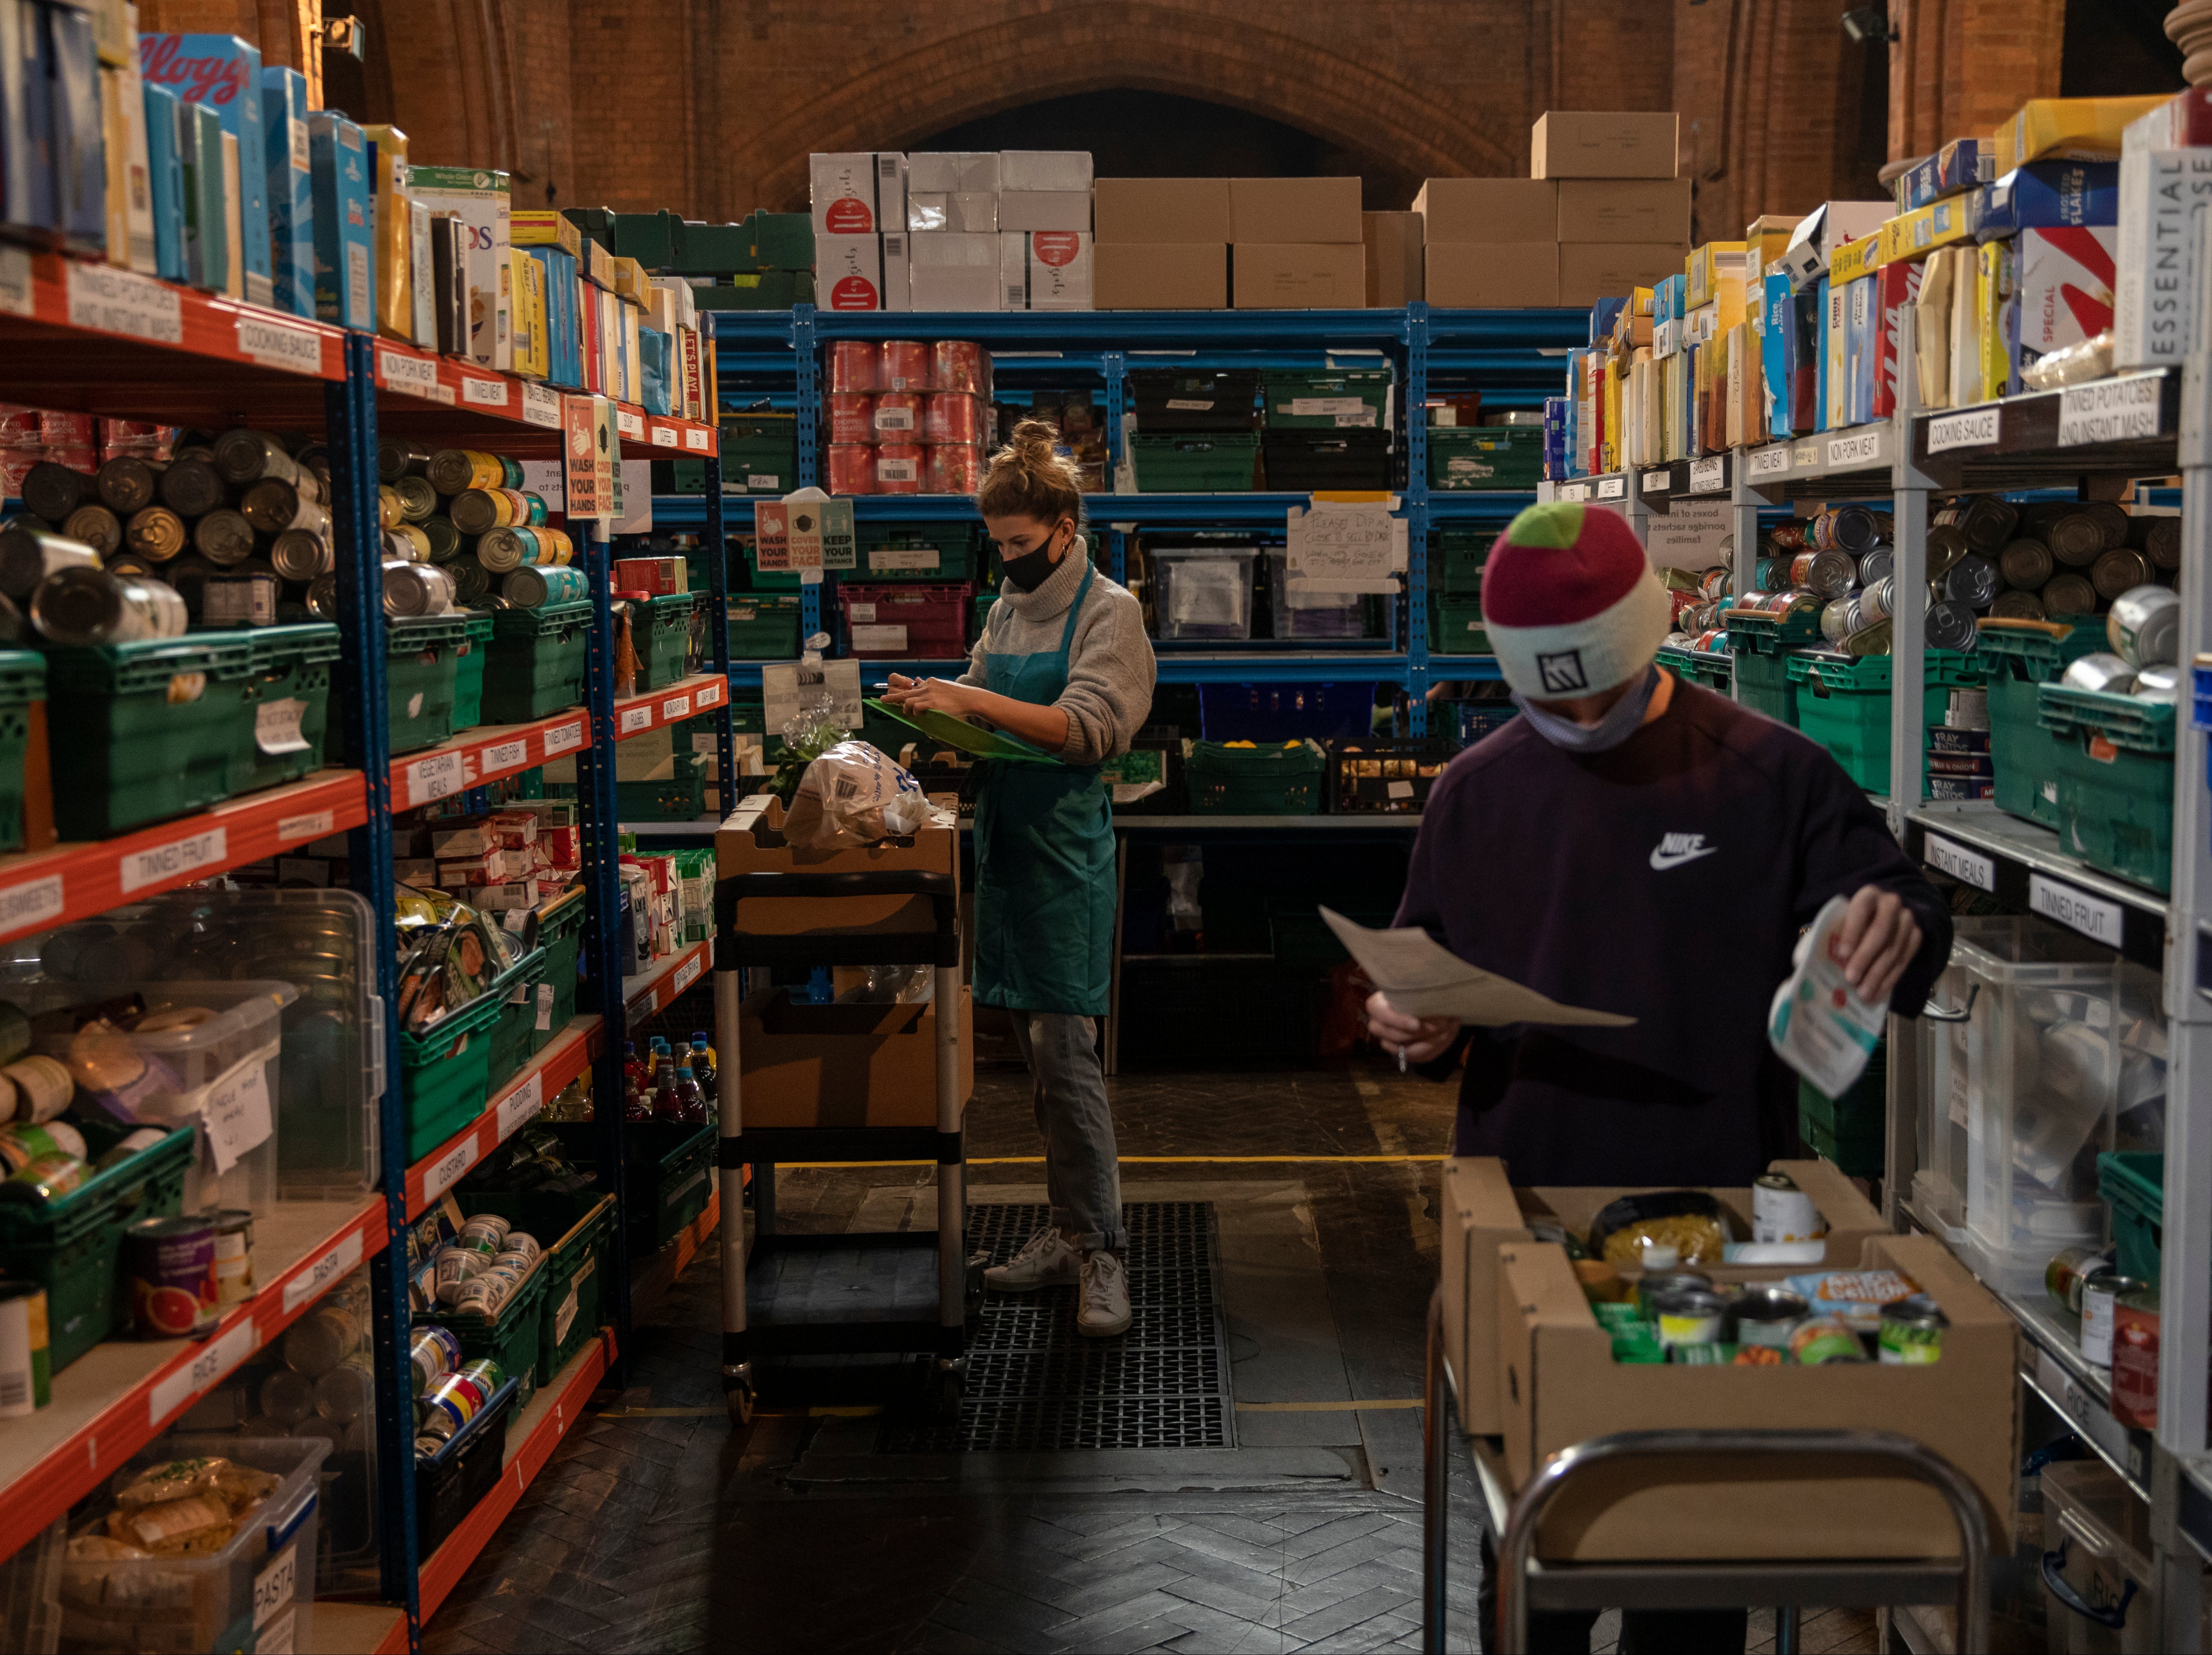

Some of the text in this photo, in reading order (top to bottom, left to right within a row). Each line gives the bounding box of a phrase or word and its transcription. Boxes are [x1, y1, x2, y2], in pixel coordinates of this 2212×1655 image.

[2070, 168, 2084, 225] FLAKES
[2152, 158, 2182, 355] ESSENTIAL
[1771, 300, 1780, 326] Rice
[2043, 286, 2055, 343] SPECIAL
[246, 324, 317, 360] COOKING SAUCE
[687, 332, 699, 367] LET'S
[2063, 380, 2153, 413] TINNED POTATOES
[624, 414, 633, 428] SOUP
[2081, 418, 2119, 444] INSTANT
[2120, 412, 2154, 437] MASH
[660, 430, 671, 442] COFFEE
[1931, 416, 1993, 445] COOKING SAUCE
[1830, 443, 1842, 461] NON
[1844, 440, 1858, 459] PORK
[1859, 436, 1875, 456] MEAT
[570, 459, 594, 473] WASH
[597, 461, 611, 474] COVER
[1704, 456, 1717, 473] BEANS
[1754, 453, 1769, 470] TINNED
[1770, 451, 1782, 468] MEAT
[570, 479, 595, 494] YOUR
[597, 477, 611, 493] YOUR
[1605, 481, 1616, 494] COFFEE
[1650, 474, 1658, 488] SOUP
[570, 499, 596, 512] HANDS
[598, 495, 612, 512] FACE
[760, 536, 787, 544] WASH
[791, 536, 819, 544] COVER
[824, 535, 852, 545] KEEP
[760, 548, 787, 556] YOUR
[791, 546, 820, 555] YOUR
[825, 548, 852, 556] YOUR
[792, 556, 820, 566] FACE
[631, 711, 644, 726] PULSES
[545, 723, 581, 746] TINNED TOMATOES
[1935, 732, 1959, 743] FRAY
[1934, 741, 1969, 752] BENTOS
[490, 747, 520, 765] TINNED FISH
[418, 755, 455, 778] VEGETARIAN
[1952, 761, 1975, 771] ONION
[428, 778, 447, 799] MEALS
[1932, 780, 1956, 790] FRAY
[1932, 788, 1965, 799] BENTOS
[1659, 831, 1707, 856] NIKE
[1930, 843, 1985, 886] INSTANT MEALS
[634, 897, 646, 913] LY!
[2041, 887, 2105, 935] TINNED FRUIT
[677, 968, 690, 985] SINGLE
[510, 1083, 531, 1112] PUDDING
[440, 1150, 466, 1185] CUSTARD
[193, 1349, 218, 1386] RICE
[2067, 1385, 2089, 1426] RICE
[256, 1560, 294, 1615] PASTA
